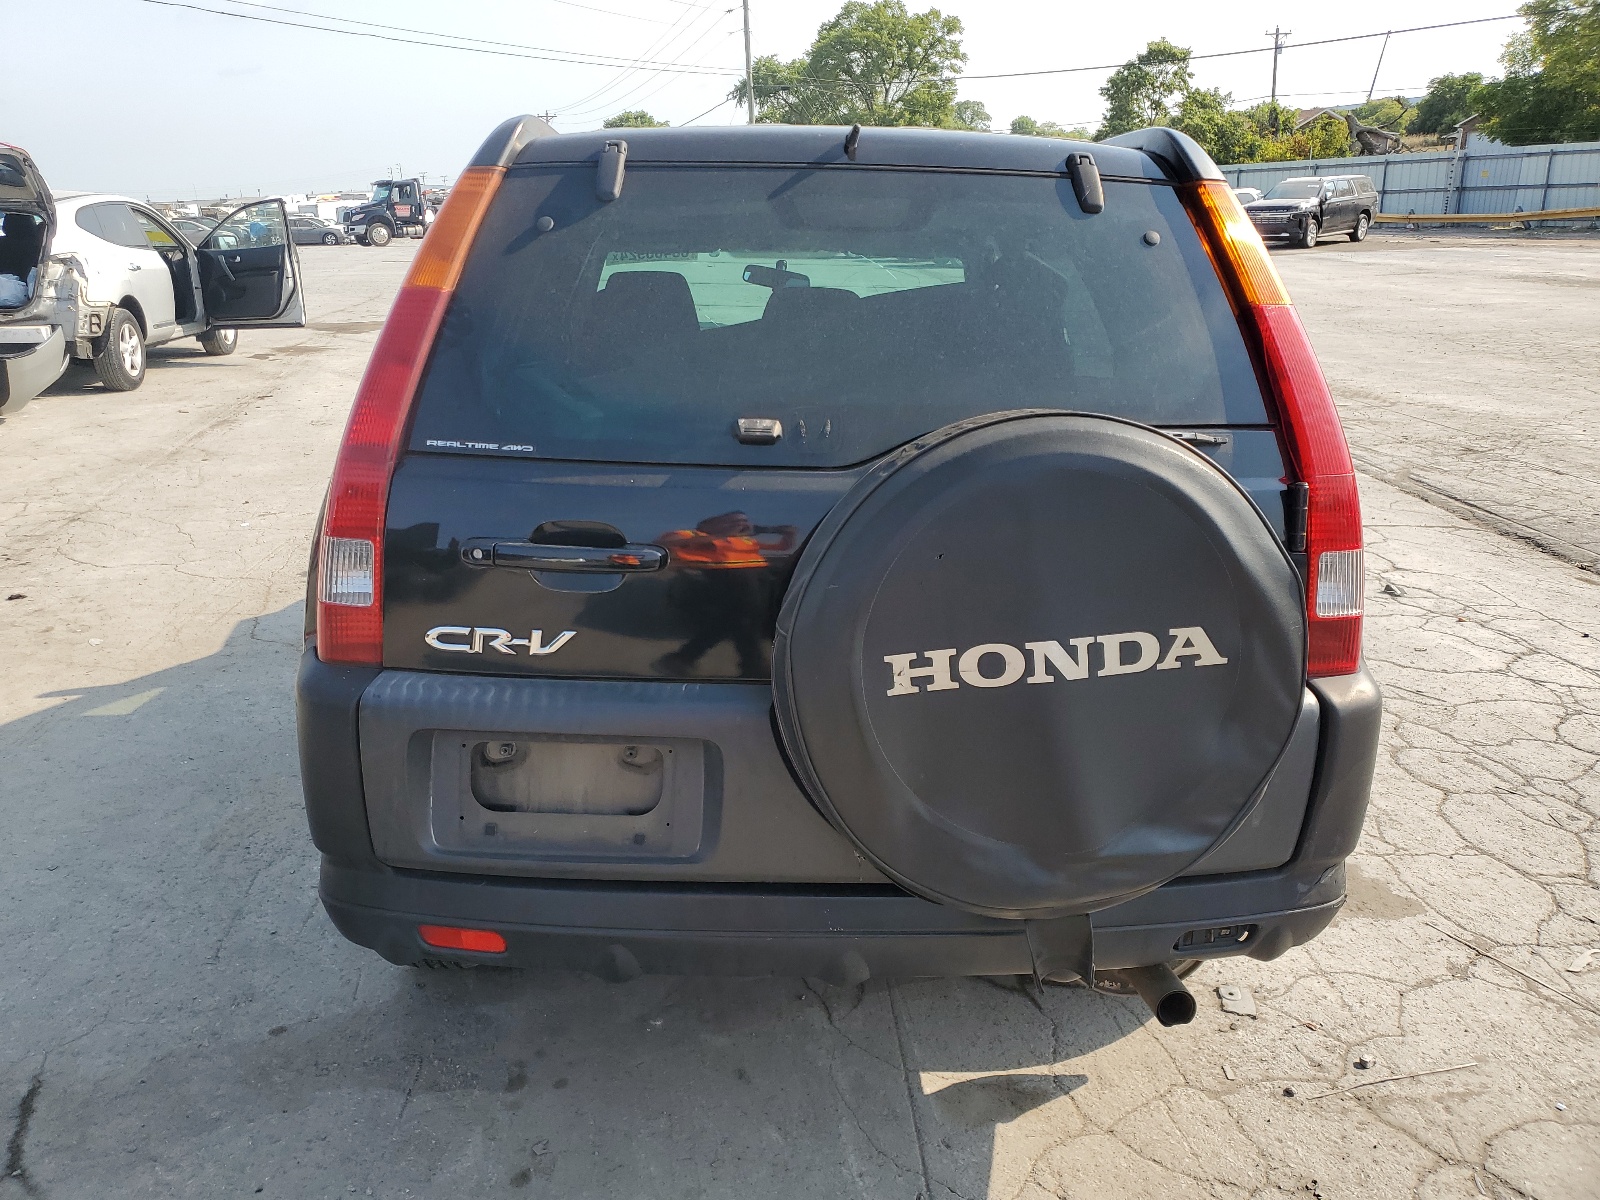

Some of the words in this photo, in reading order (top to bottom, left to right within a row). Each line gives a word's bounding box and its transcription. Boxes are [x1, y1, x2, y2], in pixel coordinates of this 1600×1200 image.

[501, 444, 534, 452] 4WD
[424, 626, 578, 656] CR-V
[883, 626, 1229, 697] HONDA
